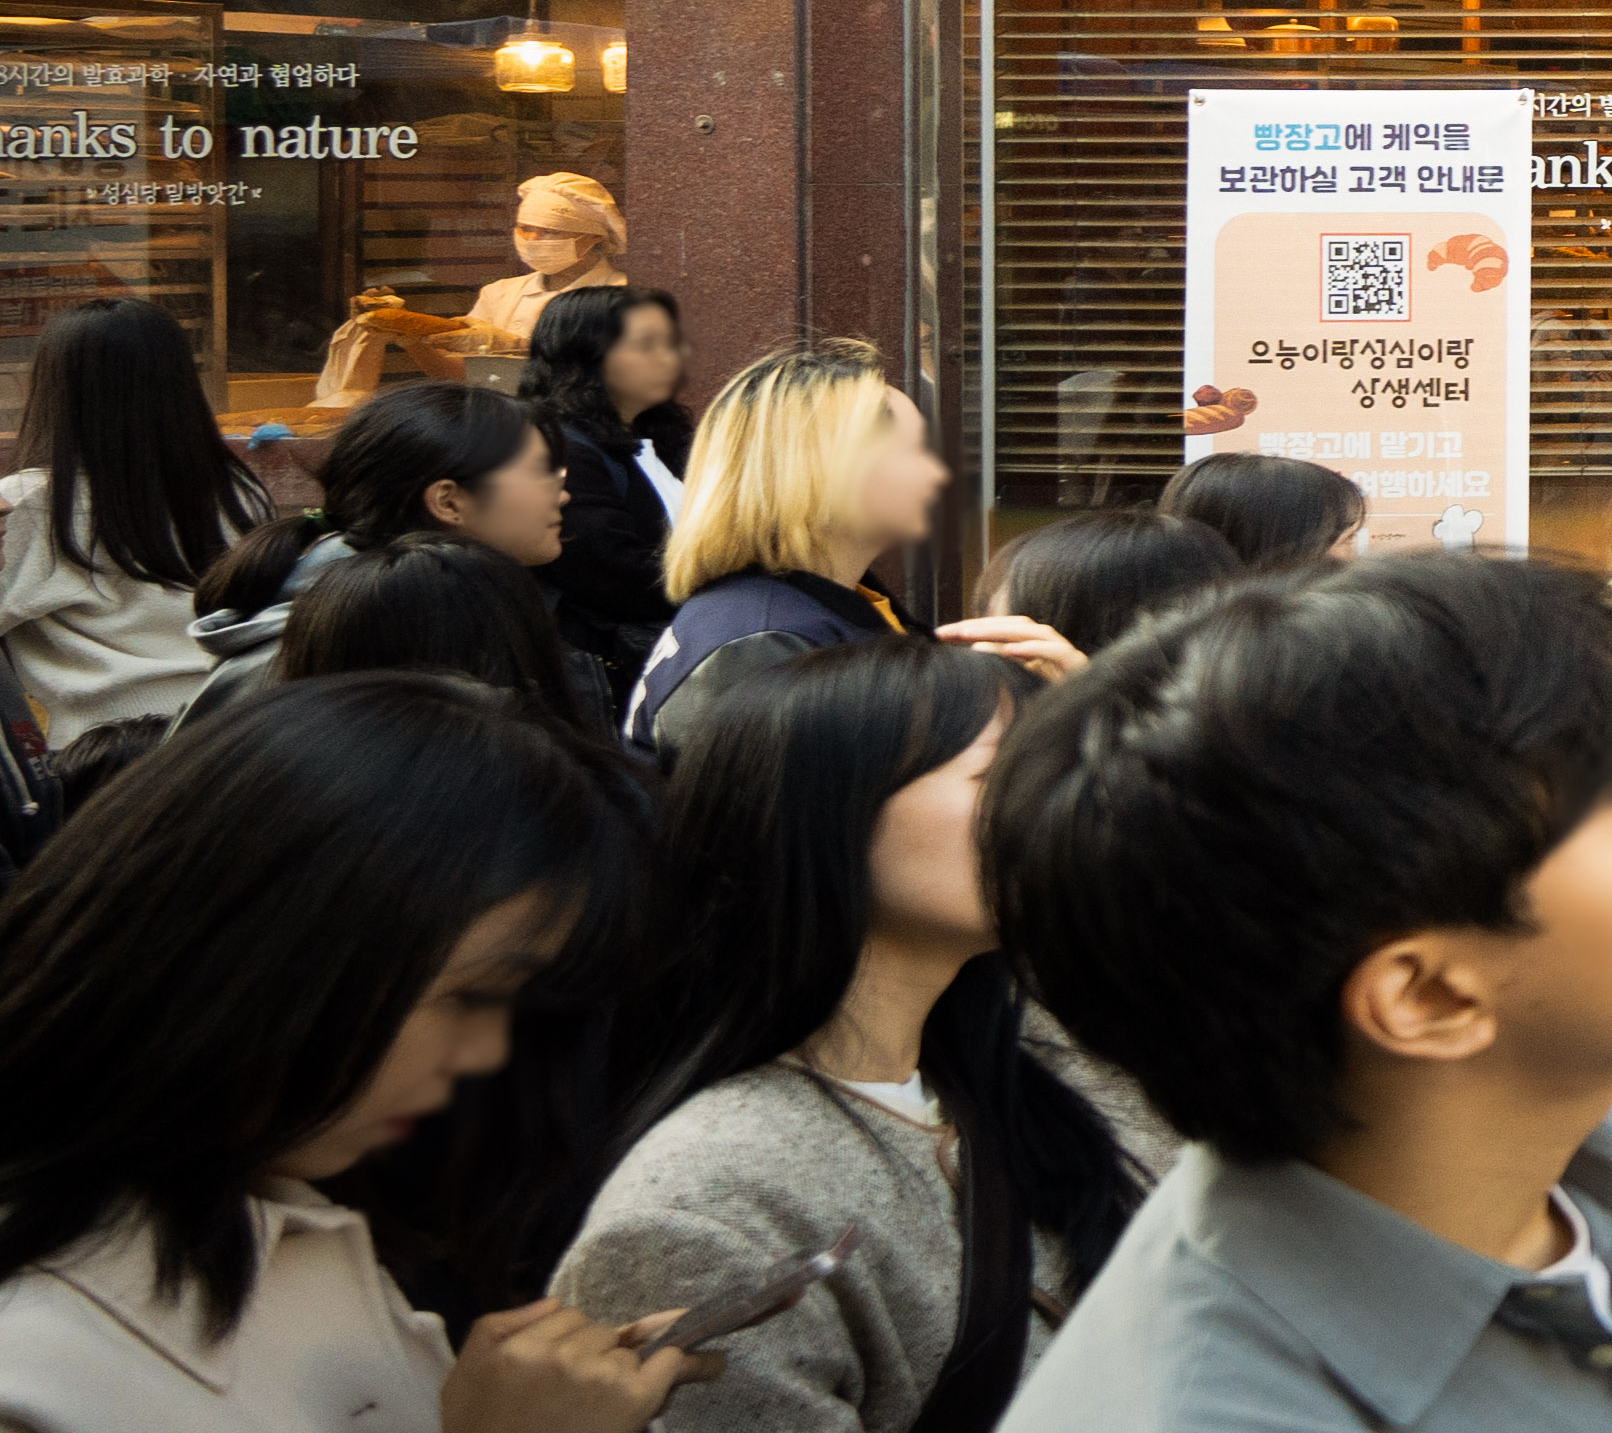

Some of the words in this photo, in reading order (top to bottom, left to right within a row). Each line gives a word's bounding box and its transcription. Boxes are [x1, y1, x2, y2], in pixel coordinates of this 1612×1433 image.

[82, 62, 173, 88] 발효과학
[193, 62, 264, 88] 자연과
[270, 62, 360, 88] 협업하다
[161, 115, 213, 159] to
[241, 115, 419, 159] nature
[1254, 123, 1372, 151] 빵장고에
[1382, 123, 1471, 151] 케익을
[1218, 165, 1339, 193] 보관하실
[1348, 165, 1407, 193] 고객
[1416, 165, 1505, 193] 안내문
[102, 182, 161, 207] 성심당
[167, 182, 249, 207] 밀방앗간
[1351, 377, 1470, 409] 상생센터
